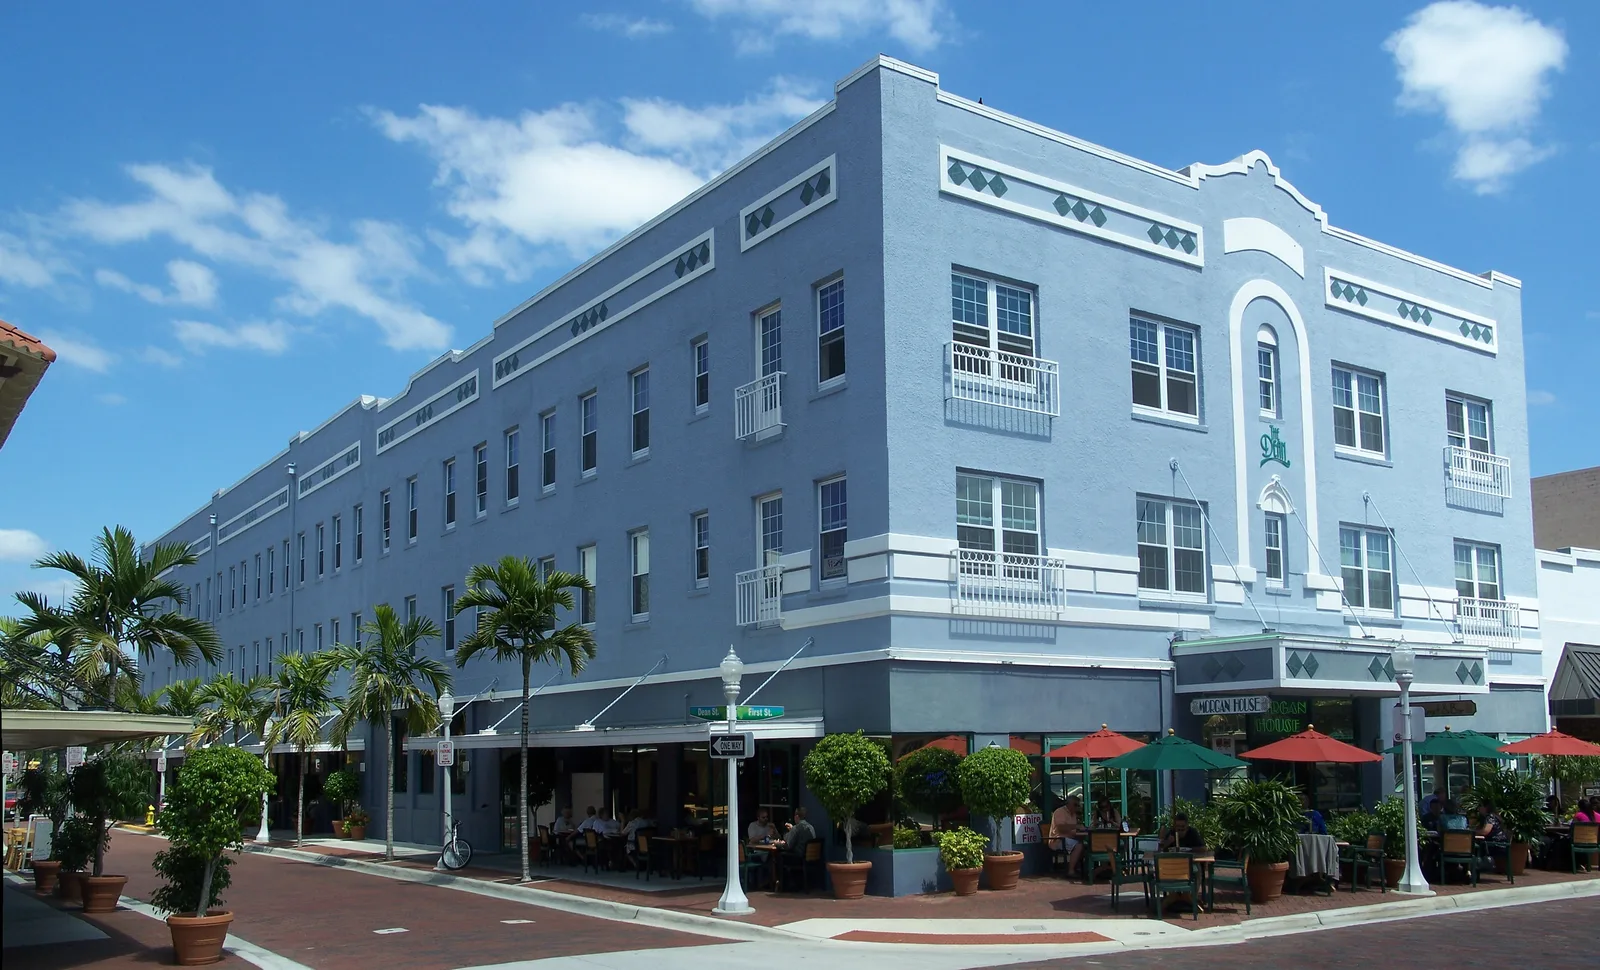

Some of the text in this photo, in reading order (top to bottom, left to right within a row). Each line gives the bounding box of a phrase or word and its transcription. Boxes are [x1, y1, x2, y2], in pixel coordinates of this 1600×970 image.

[1199, 697, 1260, 714] MORGAN HOUSE
[1269, 700, 1307, 715] RGAN
[697, 707, 720, 716] Dean St.
[748, 708, 773, 717] First St.
[1255, 718, 1300, 733] HOUSE
[720, 741, 742, 750] ONE WAY
[1015, 815, 1041, 825] Rehire
[1024, 825, 1035, 833] the
[1022, 834, 1037, 843] Fire
